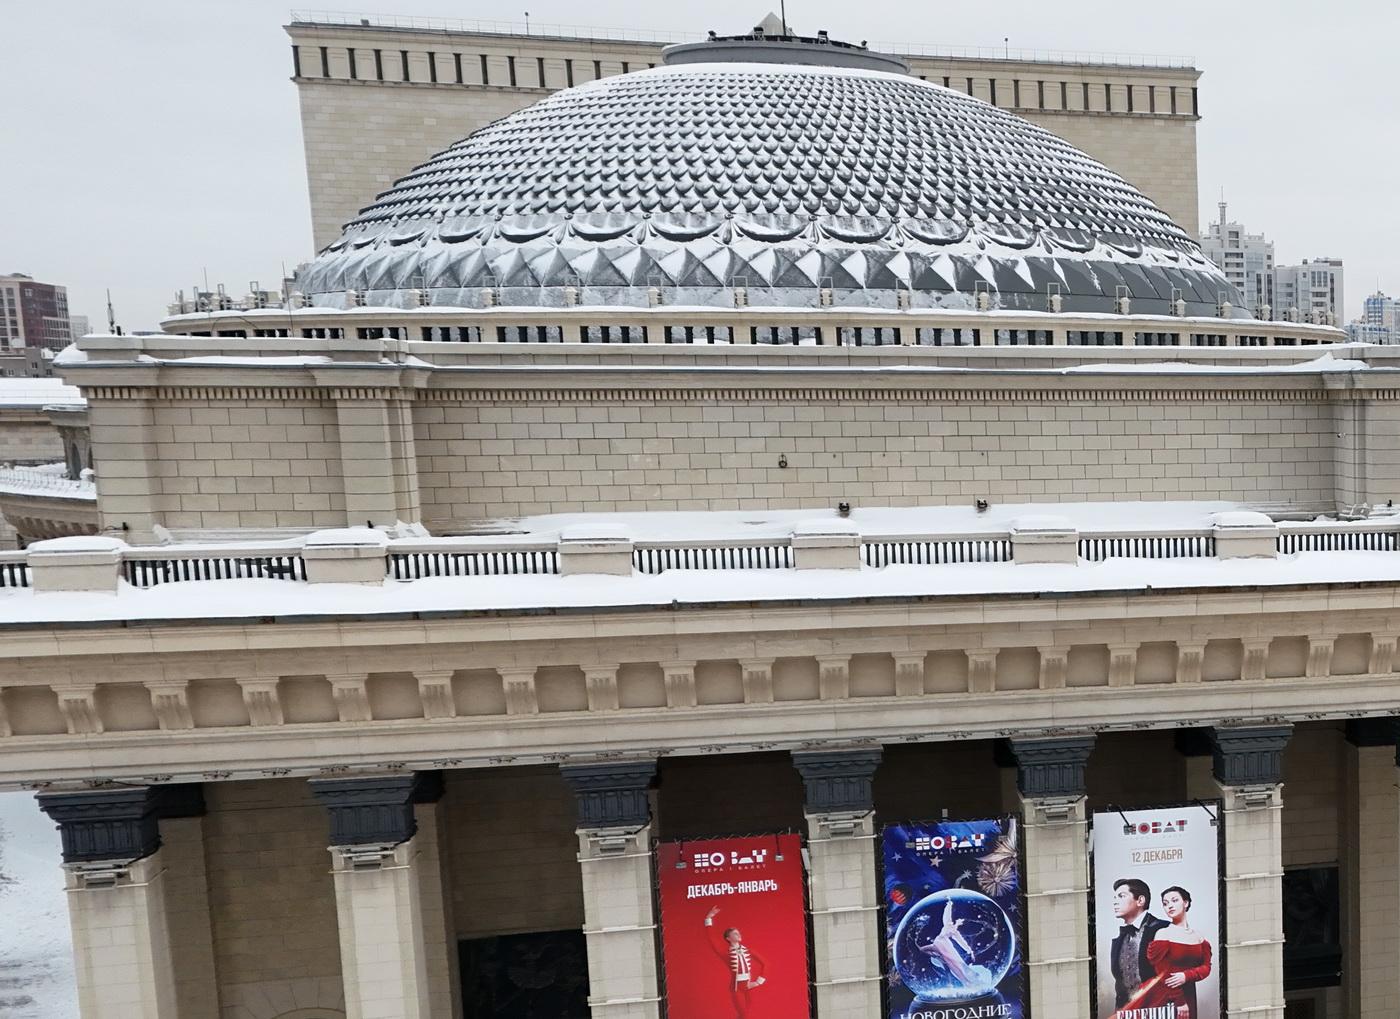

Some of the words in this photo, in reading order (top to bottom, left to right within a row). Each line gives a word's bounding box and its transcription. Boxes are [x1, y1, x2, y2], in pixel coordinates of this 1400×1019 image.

[1131, 852, 1141, 863] 12
[1143, 849, 1183, 863] ДЕКАБРЯ
[687, 880, 777, 898] ДЕКАБРЬ-ЯНВАРЬ
